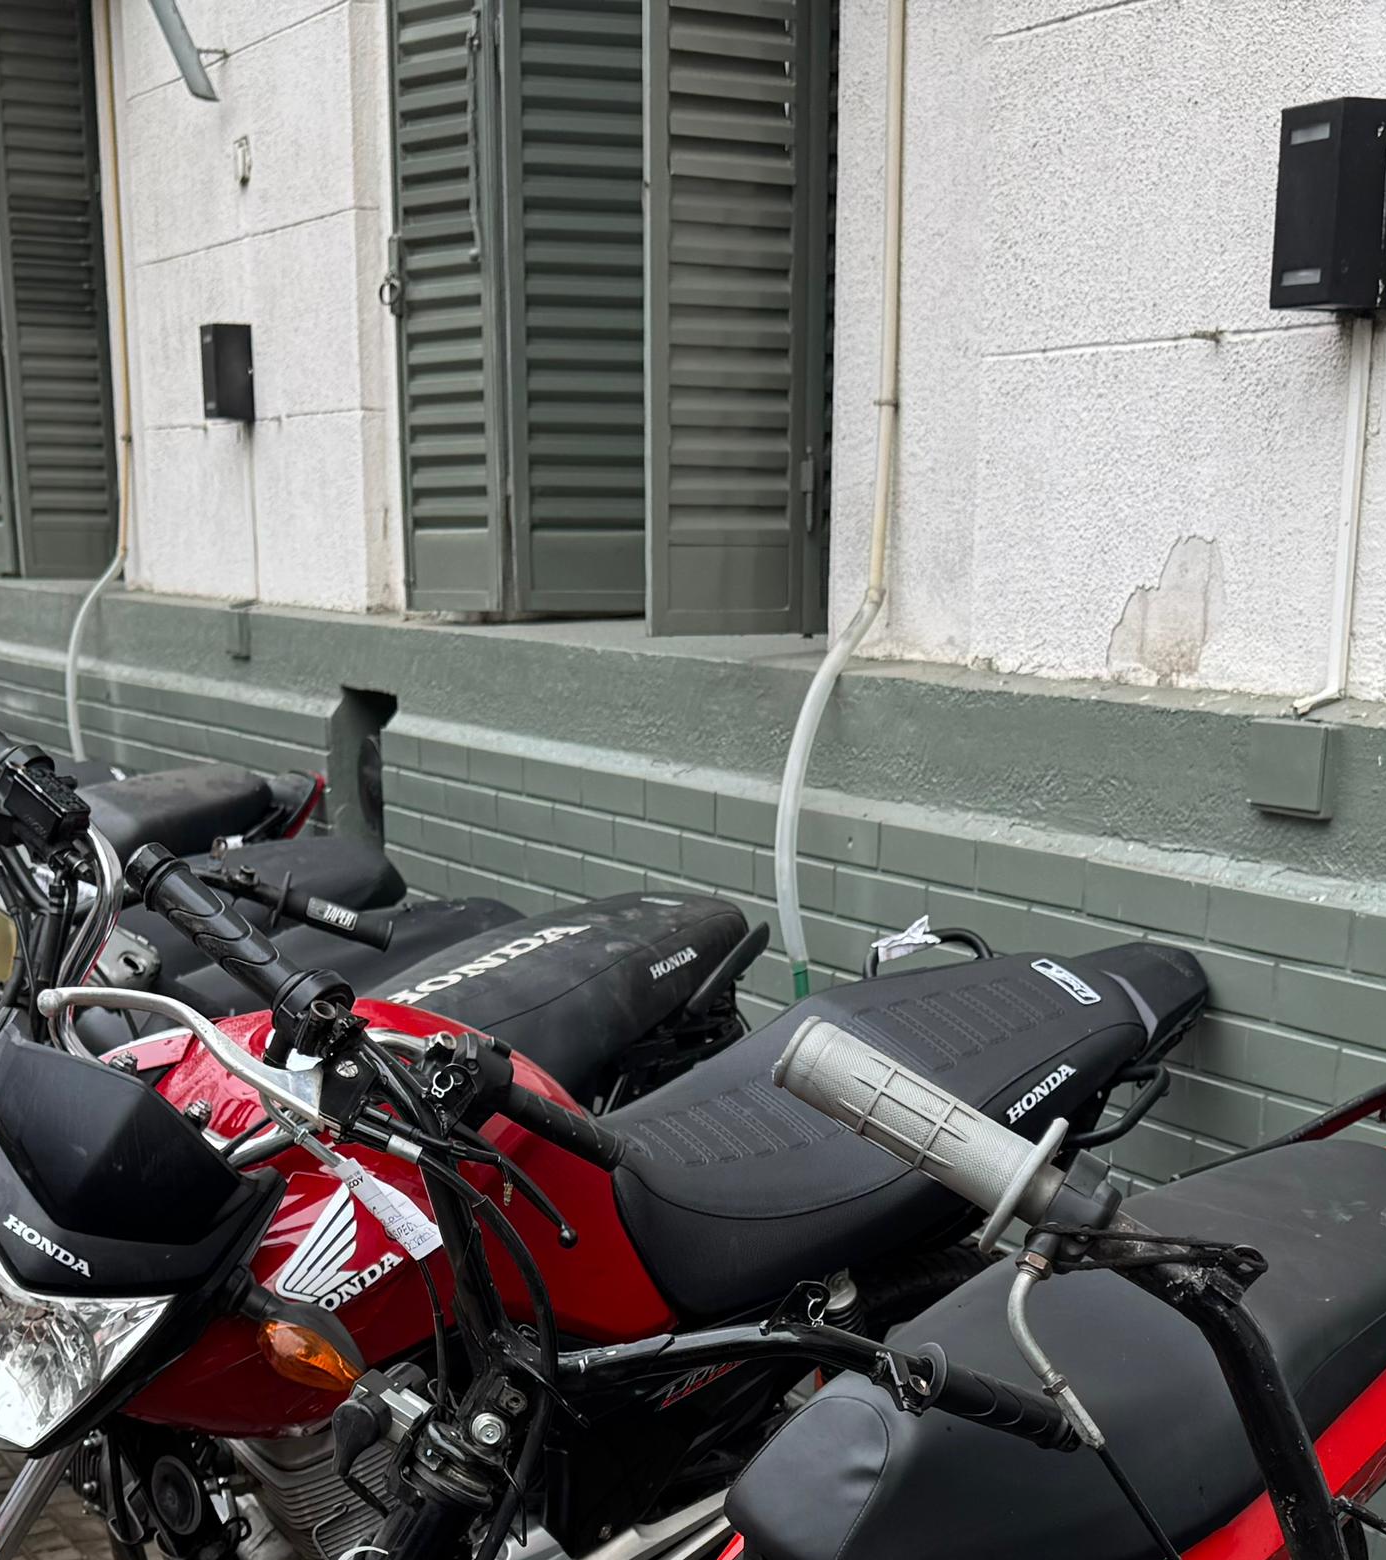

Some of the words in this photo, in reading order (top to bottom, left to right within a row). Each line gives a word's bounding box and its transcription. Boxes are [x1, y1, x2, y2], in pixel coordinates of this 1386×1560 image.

[649, 946, 698, 980] HONDA
[1006, 1063, 1077, 1124] HONDA
[3, 1214, 91, 1278] HONDA
[318, 1252, 404, 1312] ONDA
